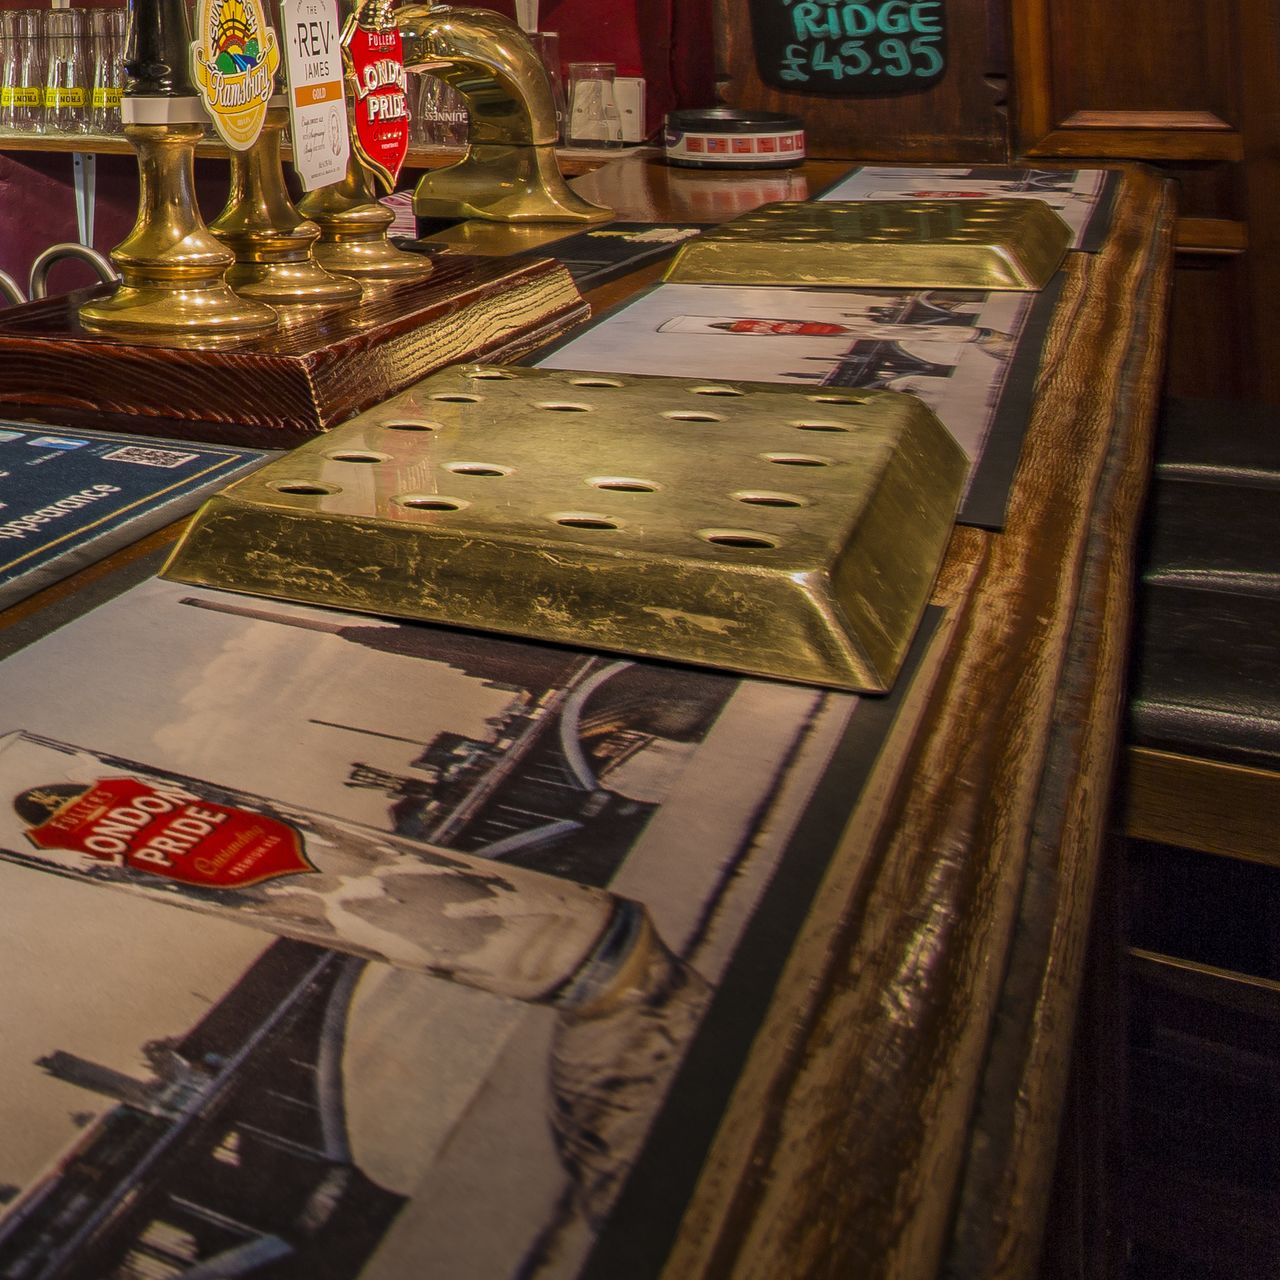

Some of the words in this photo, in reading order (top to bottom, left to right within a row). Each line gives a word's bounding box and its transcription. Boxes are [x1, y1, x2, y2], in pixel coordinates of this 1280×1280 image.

[306, 5, 318, 15] THE
[297, 20, 331, 58] REV
[304, 61, 330, 81] JAMES
[779, 36, 944, 81] £45.95
[209, 64, 271, 107] Ramsbury
[312, 88, 327, 100] GOLD
[367, 94, 407, 121] PRIDE
[81, 787, 203, 867] LONDON
[134, 805, 230, 867] PRIDE
